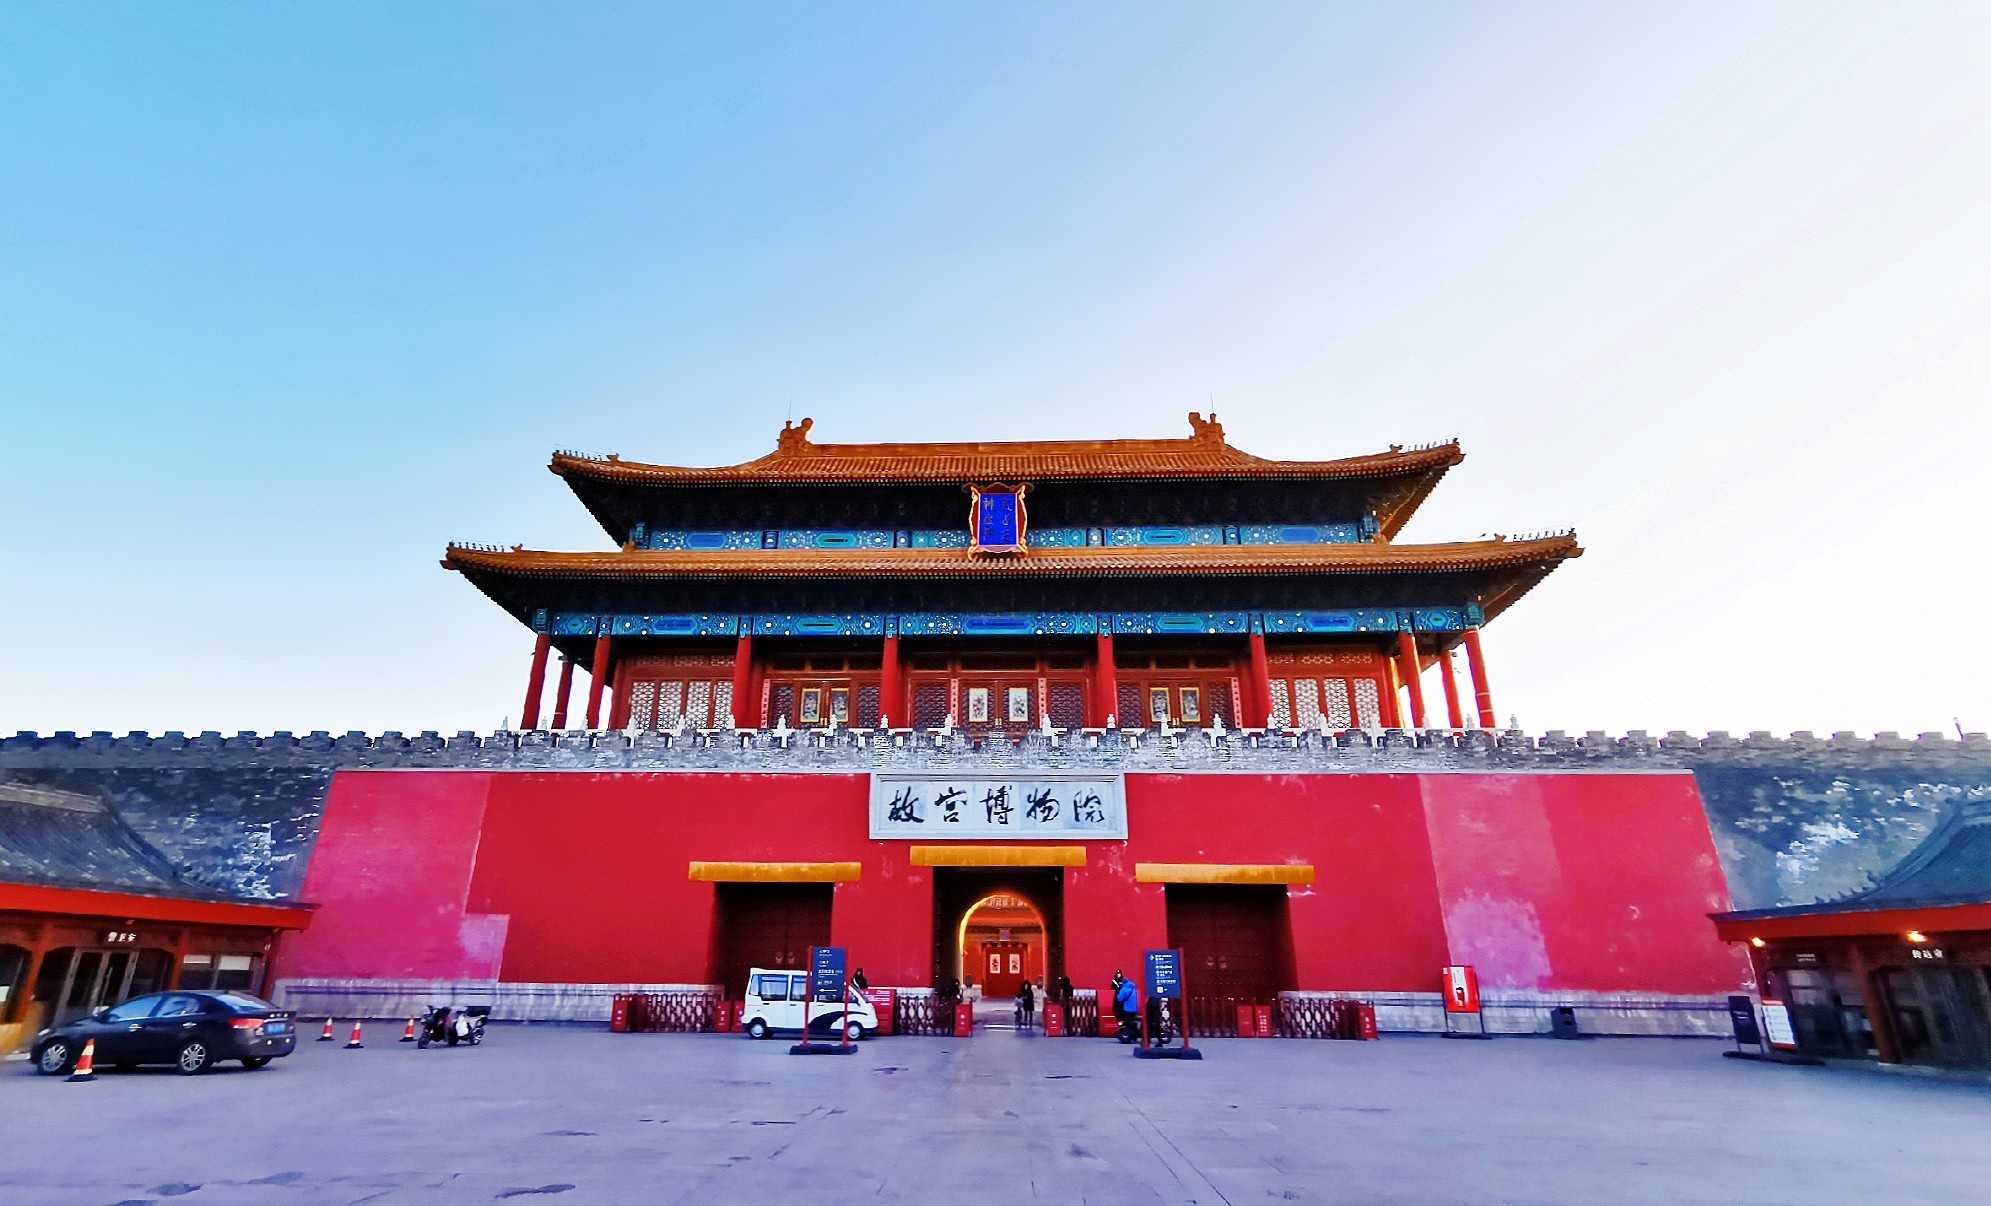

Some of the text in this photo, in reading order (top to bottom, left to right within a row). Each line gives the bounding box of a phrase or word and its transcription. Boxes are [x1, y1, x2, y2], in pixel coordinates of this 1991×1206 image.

[888, 786, 1105, 825] 故宫博物院
